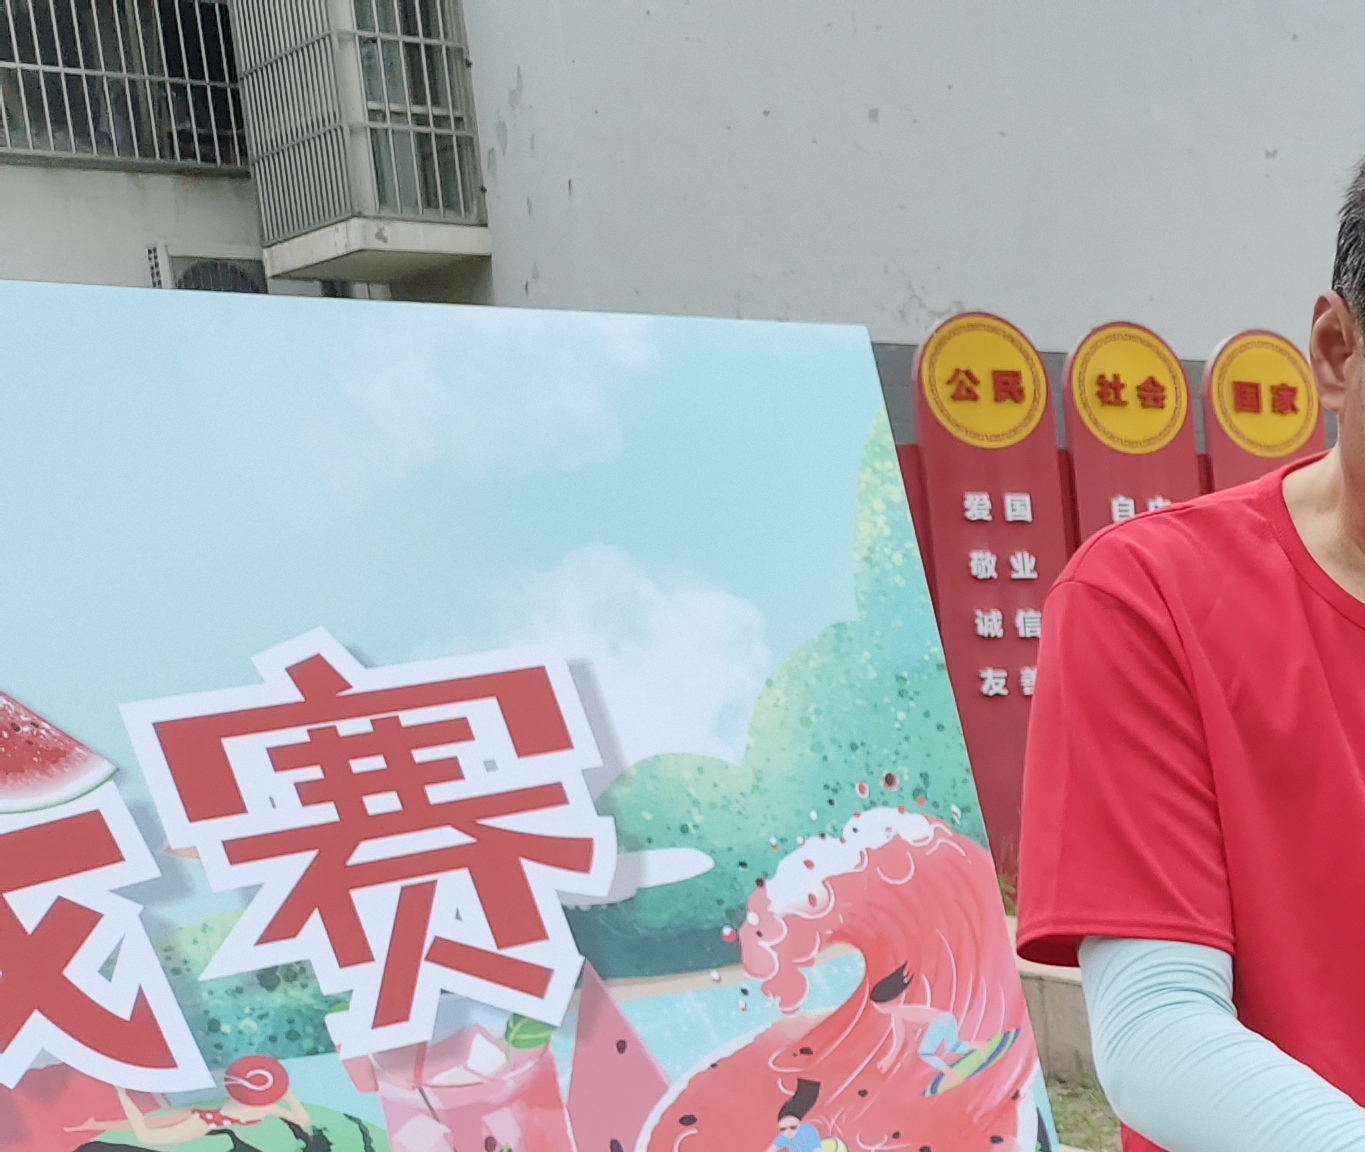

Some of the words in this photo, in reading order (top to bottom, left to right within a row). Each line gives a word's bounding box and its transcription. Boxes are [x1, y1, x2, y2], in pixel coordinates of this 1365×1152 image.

[947, 368, 1027, 404] 公民
[1096, 373, 1167, 409] 社会
[1232, 380, 1299, 415] 国家
[963, 491, 1034, 523] 爱国
[968, 549, 1039, 580] 敬业
[975, 608, 1042, 639] 诚信
